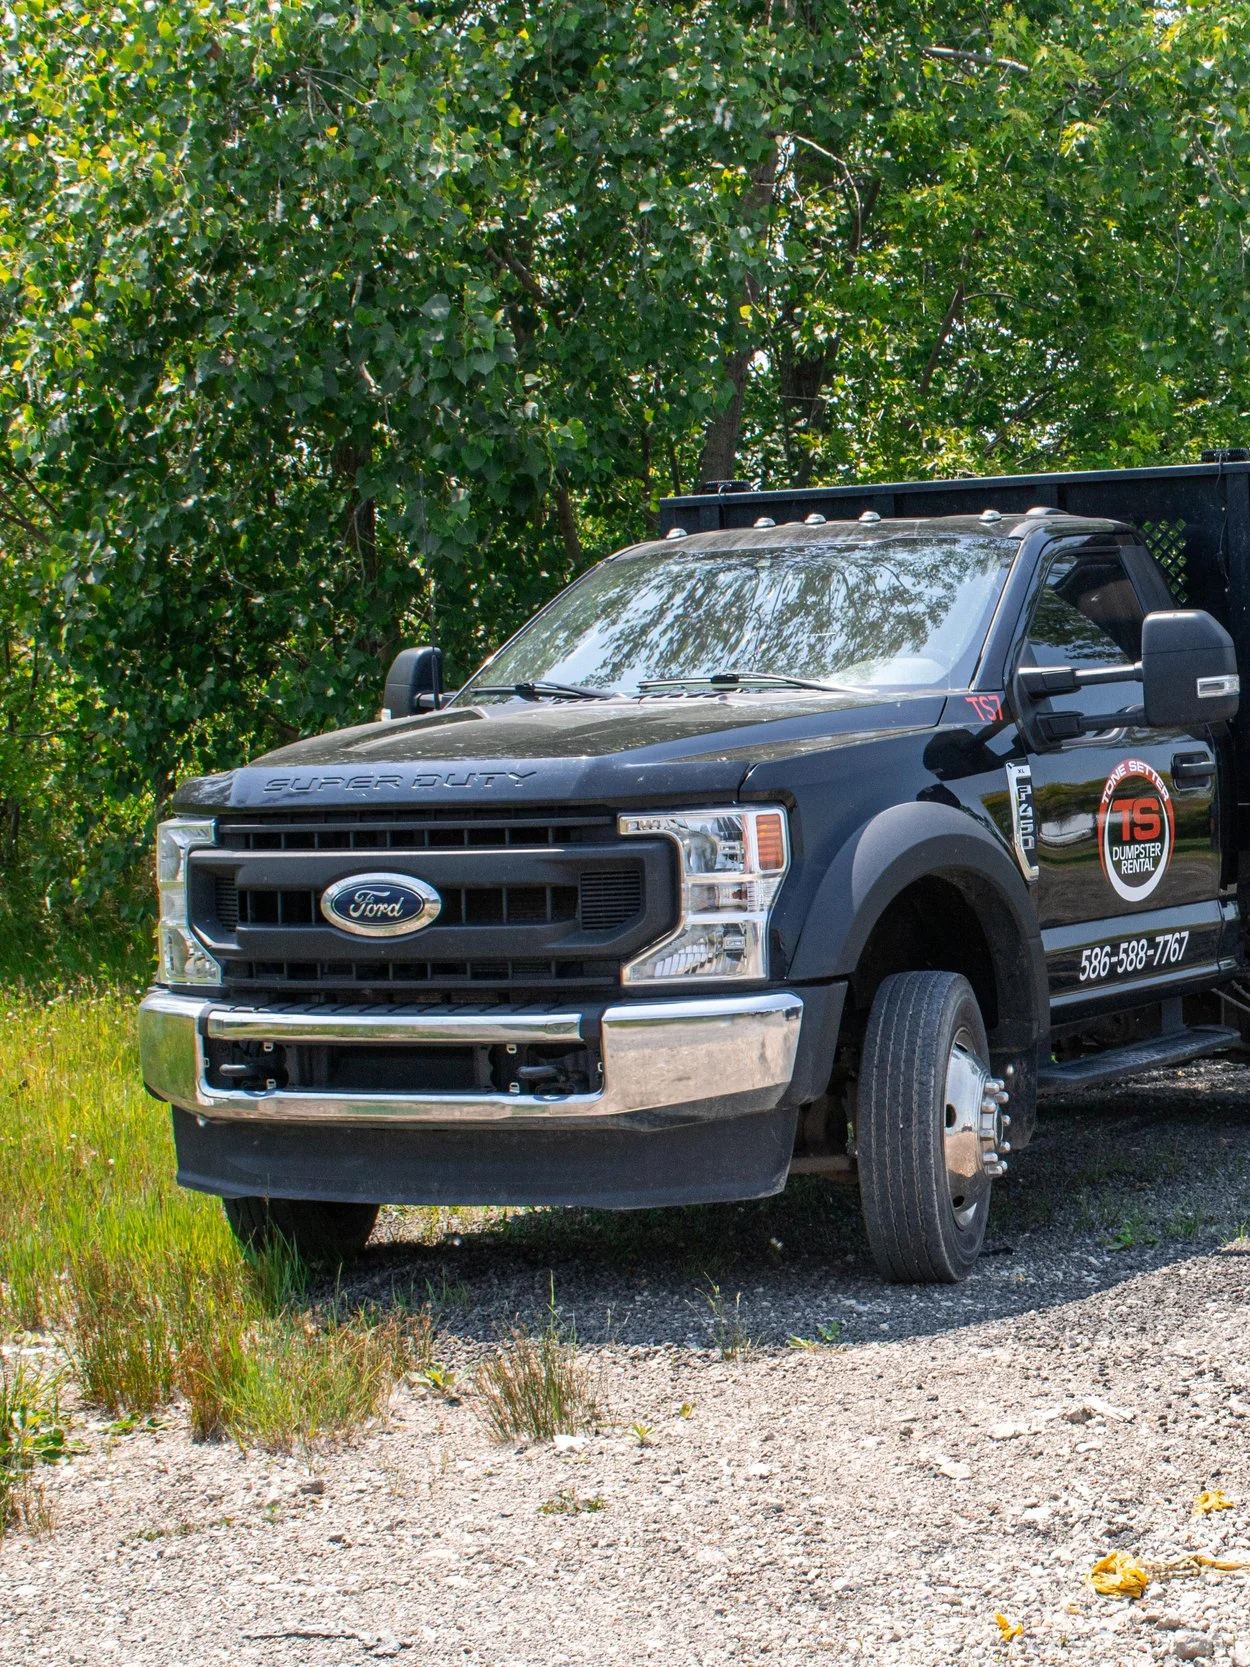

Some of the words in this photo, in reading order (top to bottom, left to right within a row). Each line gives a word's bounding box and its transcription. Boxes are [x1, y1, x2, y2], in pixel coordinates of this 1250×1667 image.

[965, 695, 1004, 721] TS7
[263, 775, 404, 793] SUPER
[411, 771, 538, 789] DUTY
[1101, 763, 1126, 804] TONE
[1128, 760, 1170, 802] SETTER
[1112, 797, 1161, 841] TS
[1112, 842, 1161, 861] DUMPSTER
[1121, 858, 1155, 875] RENTAL
[350, 889, 404, 918] Ford
[1079, 931, 1190, 981] 586-588-7767
